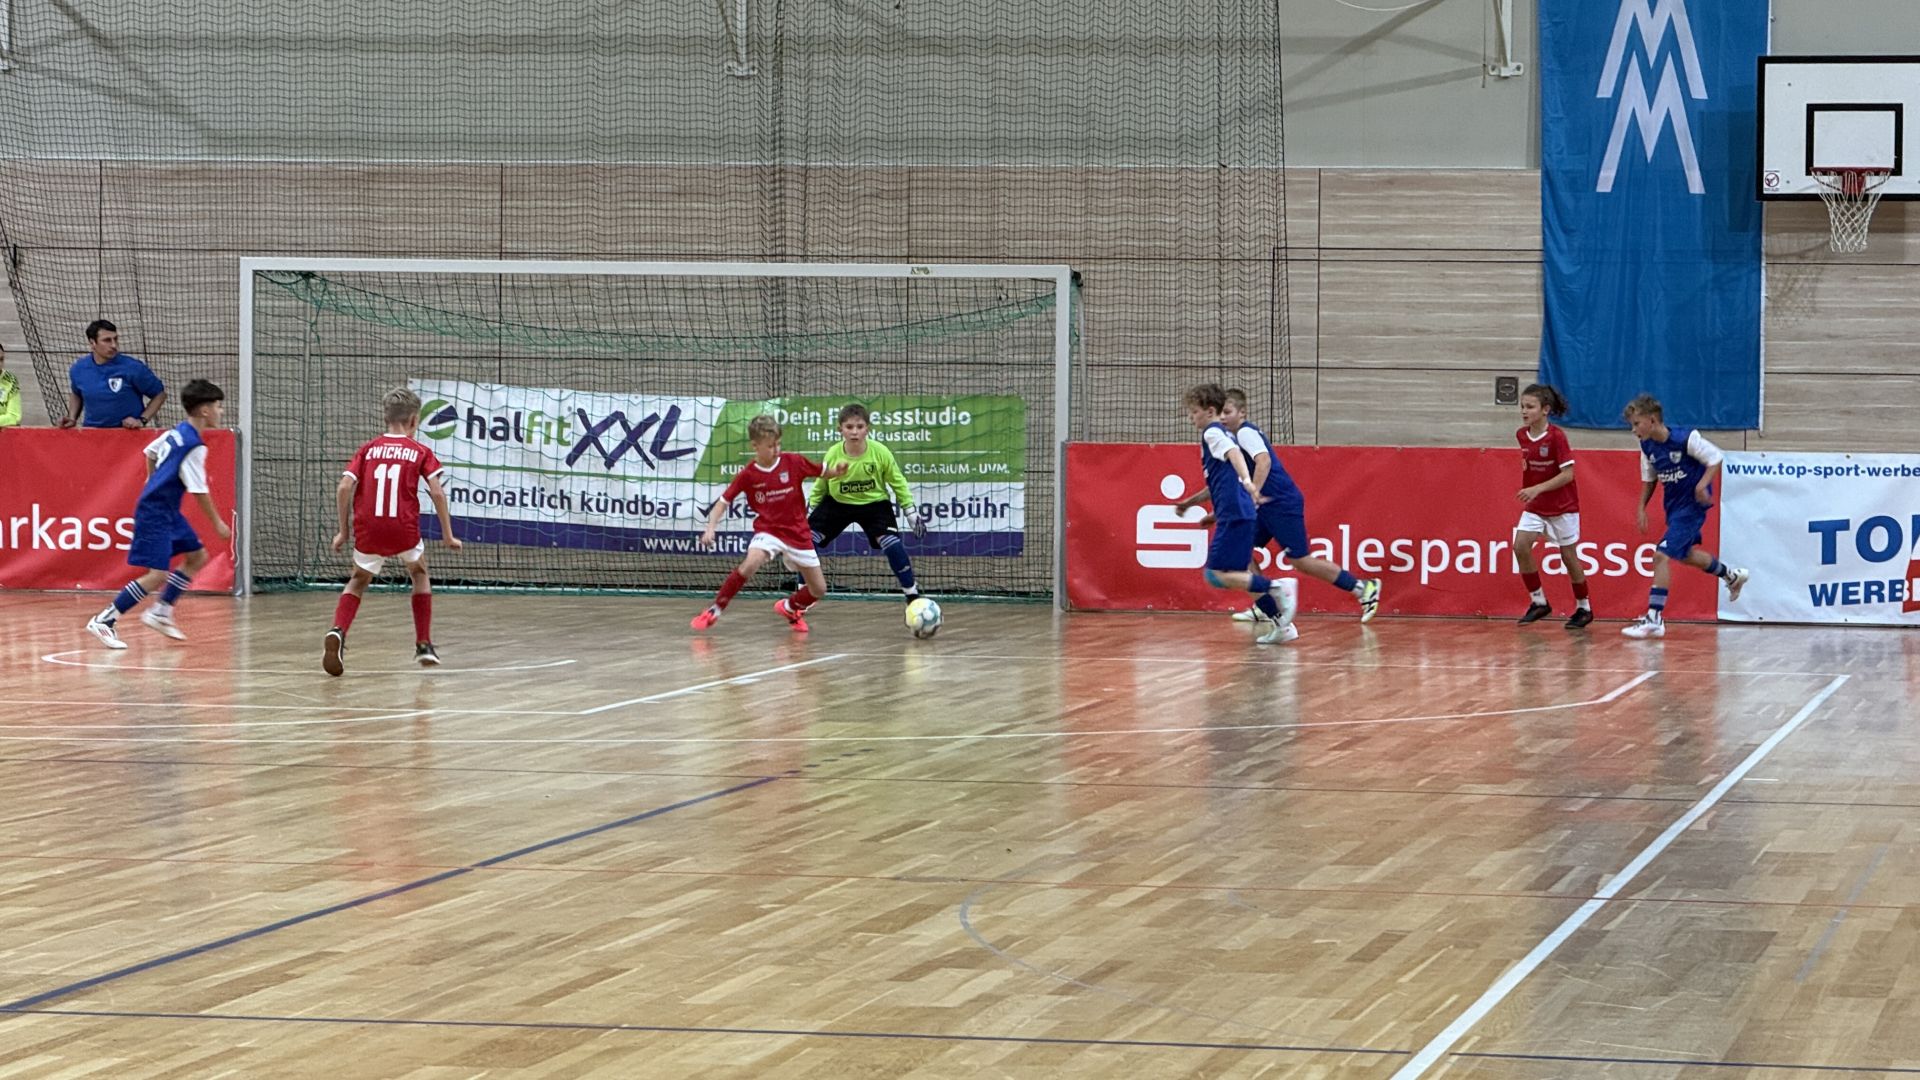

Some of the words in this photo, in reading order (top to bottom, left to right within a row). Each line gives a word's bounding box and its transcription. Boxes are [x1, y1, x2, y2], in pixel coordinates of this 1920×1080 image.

[775, 406, 822, 426] Dein
[828, 406, 971, 426] Fessstudio
[465, 407, 572, 447] halfit
[566, 404, 698, 471] XXL
[808, 428, 820, 441] in
[365, 446, 418, 463] ZWICKAU
[904, 463, 970, 475] SOLARIUM
[1727, 462, 1920, 478] www.top-sport-werbe
[374, 463, 401, 518] 11
[451, 487, 571, 511] monatlich
[580, 491, 682, 518] kündbar
[0, 504, 135, 550] rkass
[643, 535, 748, 552] www.halfit
[1808, 514, 1920, 566] TO
